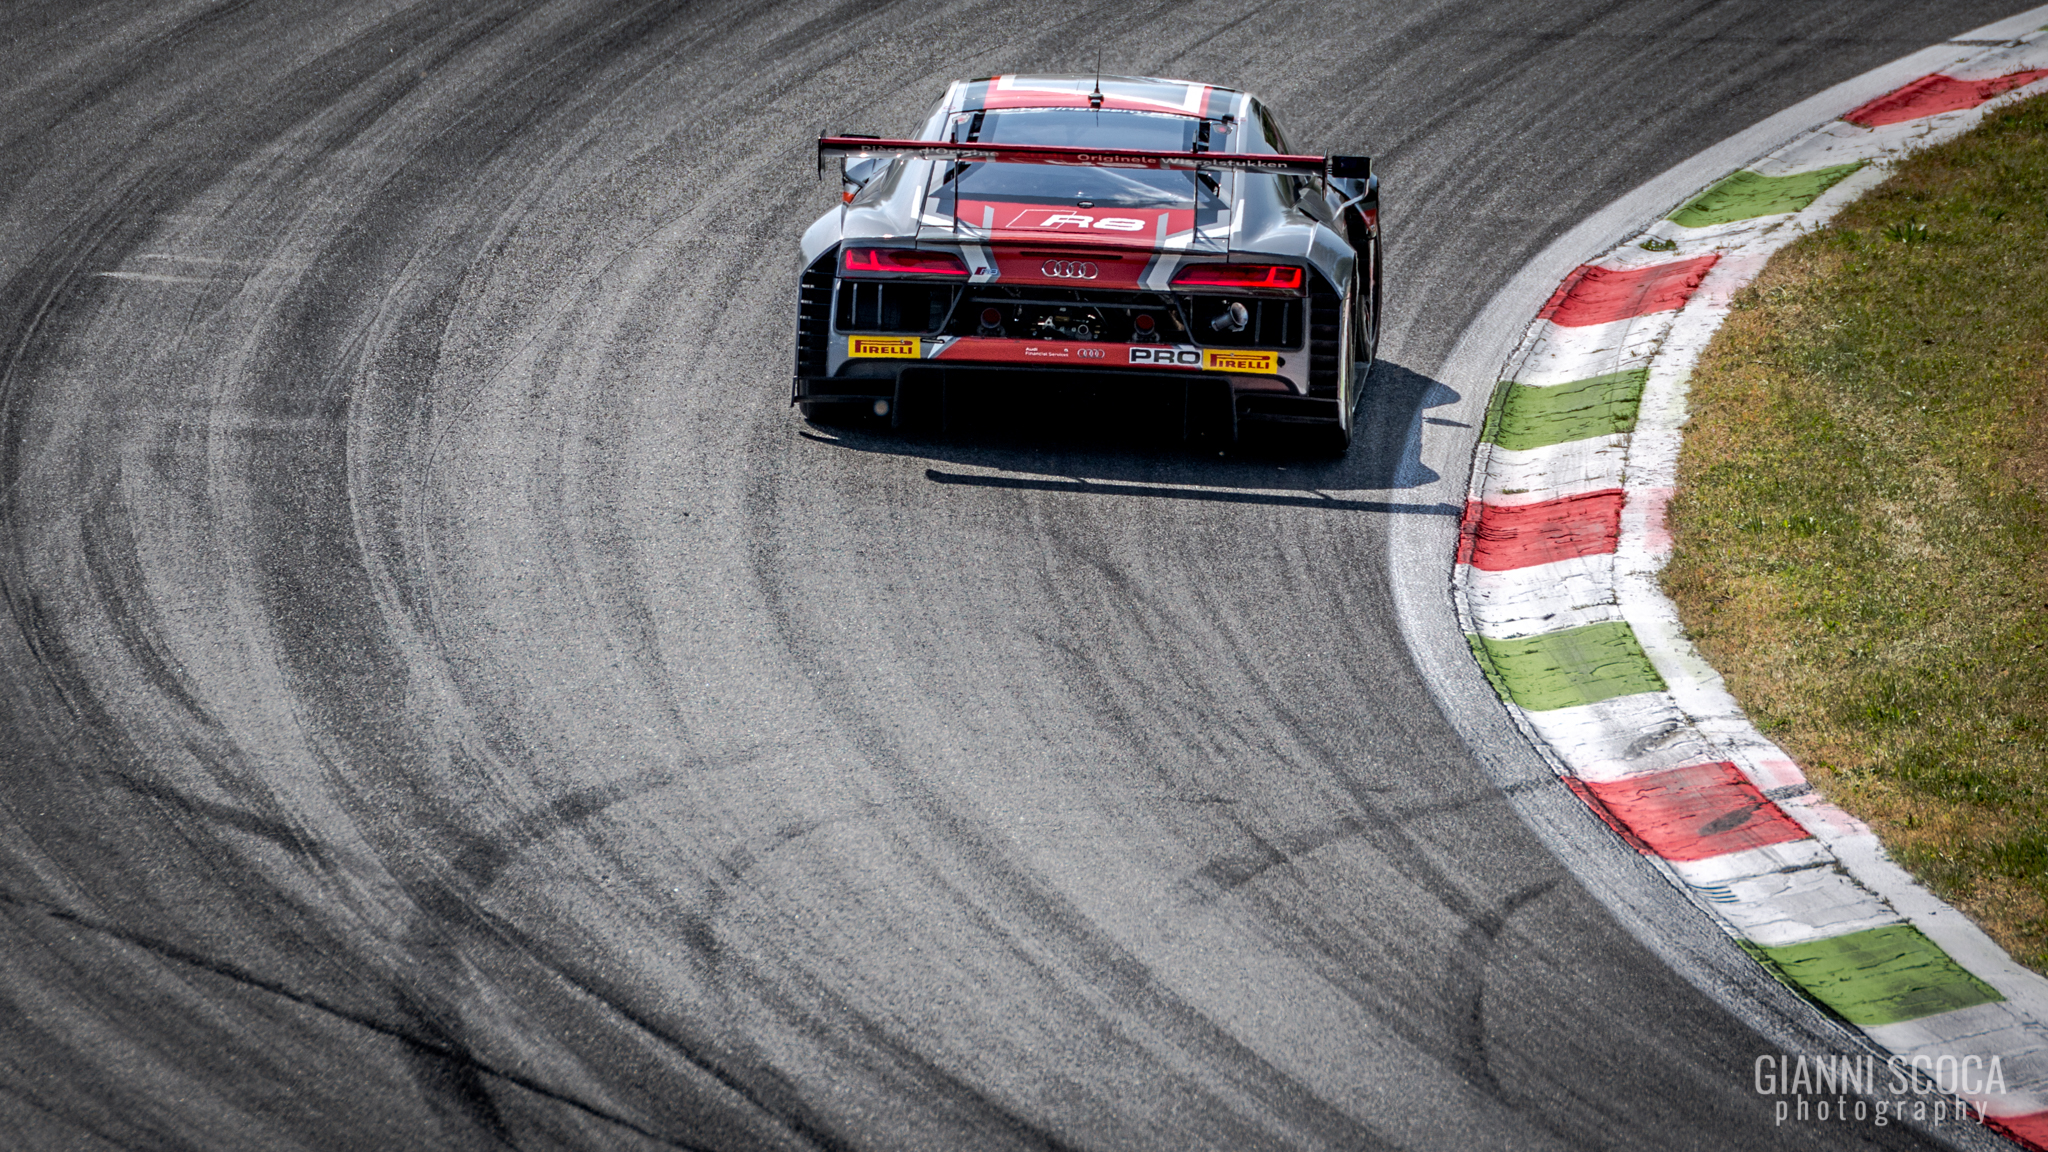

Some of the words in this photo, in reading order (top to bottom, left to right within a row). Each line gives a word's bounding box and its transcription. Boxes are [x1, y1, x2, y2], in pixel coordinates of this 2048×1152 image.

[1077, 154, 1157, 164] Originele
[1040, 214, 1145, 231] R8
[854, 339, 913, 354] PIRELLI
[1131, 348, 1200, 365] PRO
[1210, 353, 1270, 370] PIRELLI
